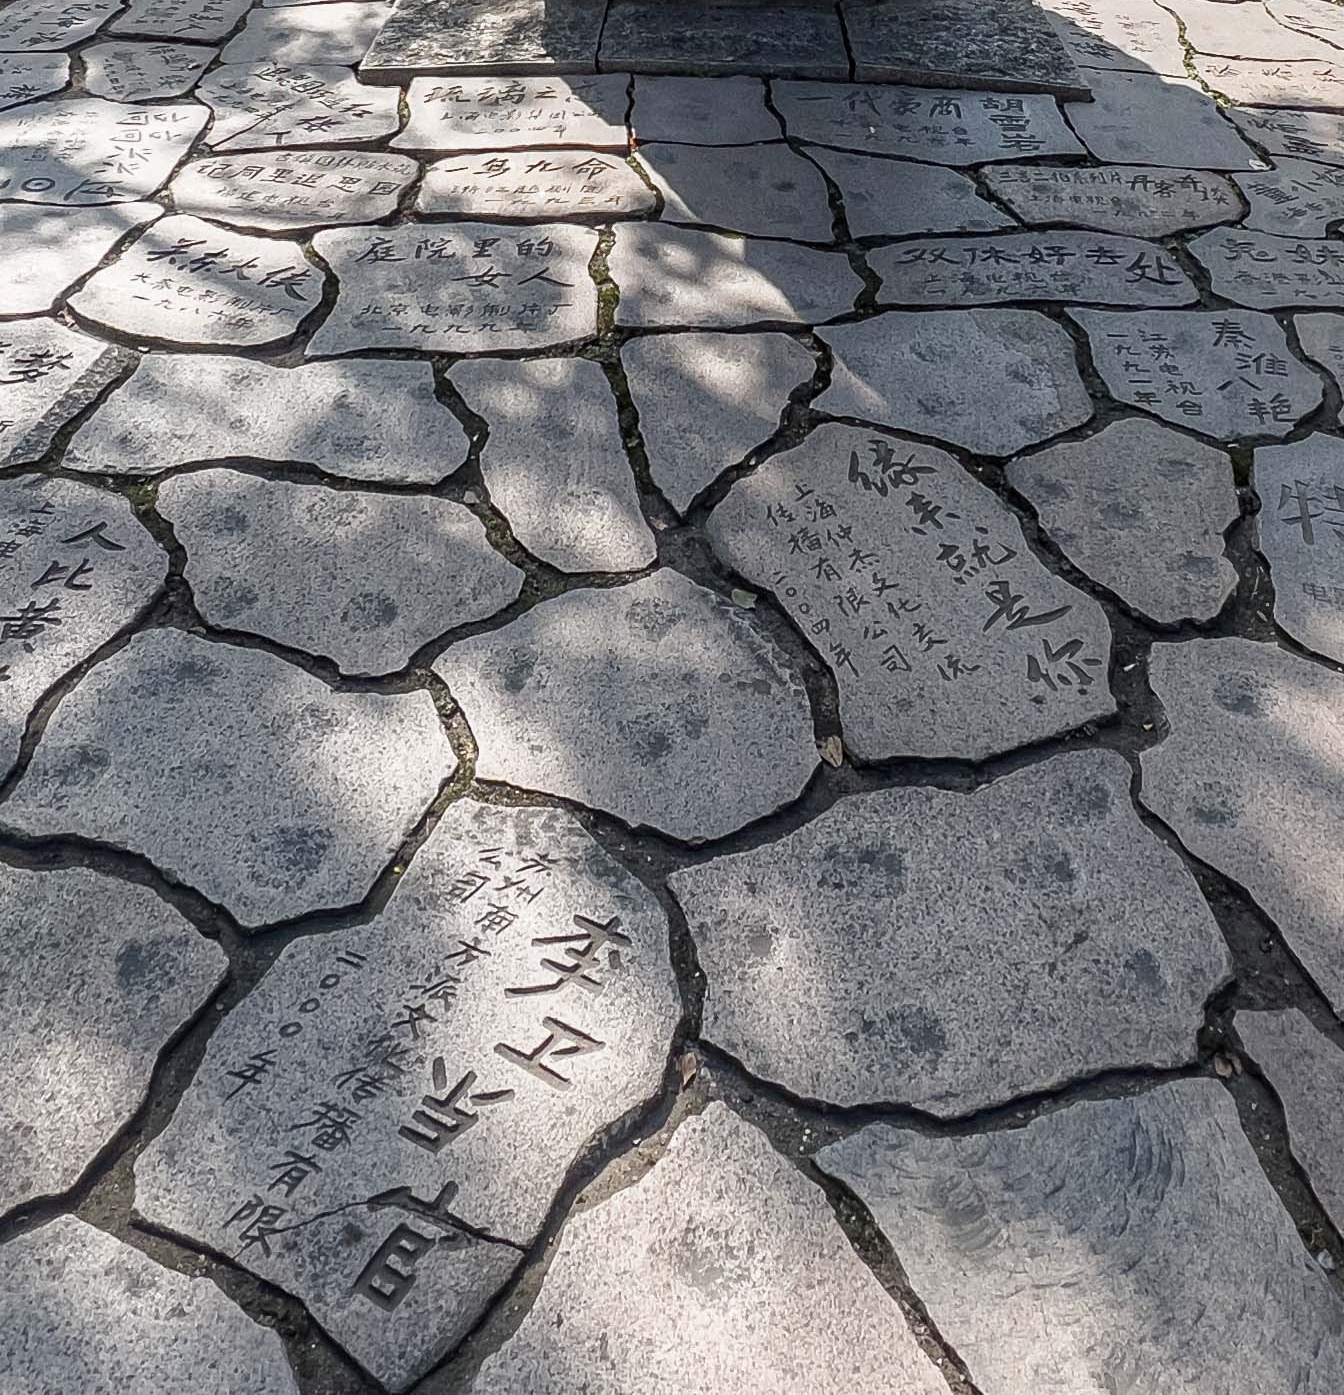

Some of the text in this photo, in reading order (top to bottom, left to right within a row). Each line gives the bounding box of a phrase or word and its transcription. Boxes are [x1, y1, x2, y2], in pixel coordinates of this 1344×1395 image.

[980, 96, 1047, 152] 胡雪岩
[355, 234, 554, 264] 庭院里的
[451, 265, 575, 289] 女人
[896, 245, 1183, 287] 双休好去处
[1105, 331, 1162, 406] 一九九一年
[1138, 327, 1204, 418] 江苏电视台
[1211, 317, 1298, 425] 秦淮八艳
[848, 439, 1103, 697] 缘来就是你
[354, 914, 632, 1311] 李卫当官
